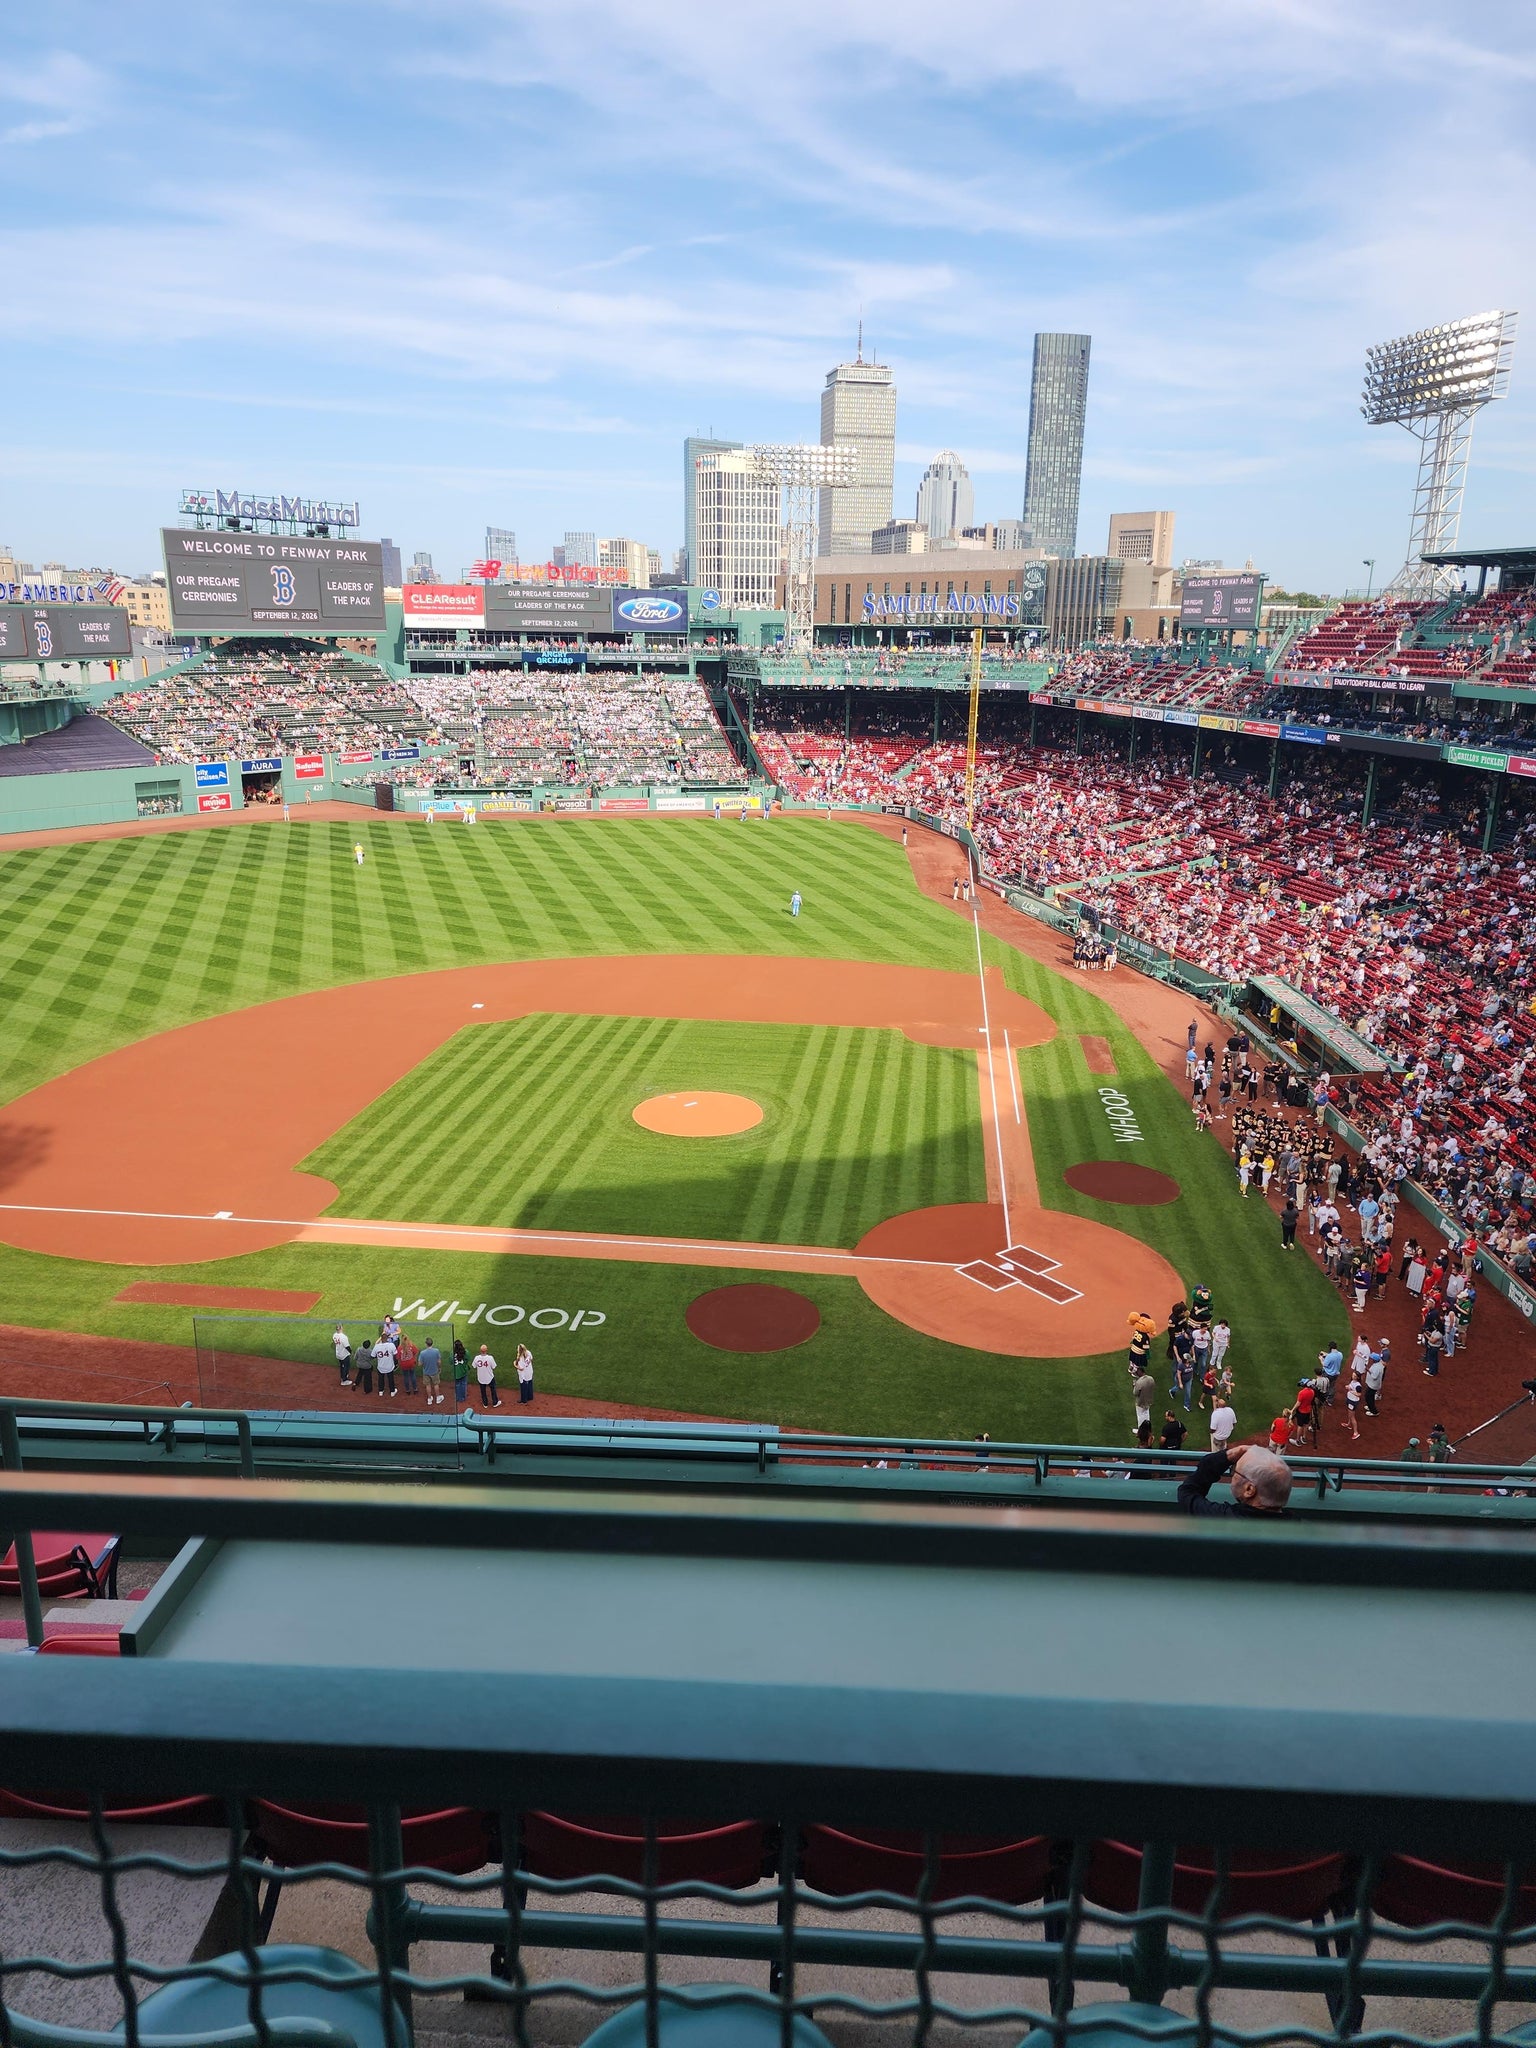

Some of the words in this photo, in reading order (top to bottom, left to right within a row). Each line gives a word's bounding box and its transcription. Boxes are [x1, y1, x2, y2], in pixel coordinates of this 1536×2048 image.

[215, 489, 360, 527] MassMutual
[182, 540, 252, 556] WELCOME
[258, 545, 275, 557] TO
[281, 547, 332, 559] FENWAY
[336, 550, 368, 562] PARK
[176, 575, 195, 585] OUR
[197, 576, 241, 587] PREGAME
[327, 581, 362, 591] LEADERS
[364, 582, 374, 592] OF
[1188, 579, 1210, 587] WELCOME
[22, 583, 96, 602] AMERICA
[182, 591, 238, 602] CEREMONIES
[333, 596, 348, 605] THE
[350, 596, 371, 606] PACK
[411, 593, 476, 605] CLEAResult
[861, 592, 944, 618] SAMUEL
[947, 591, 1020, 617] ADAMS
[631, 600, 670, 619] Ford
[253, 611, 290, 620] SEPTEMBER
[291, 611, 300, 621] 12,
[301, 611, 318, 620] 2026
[78, 622, 102, 631] LEADERS
[103, 622, 111, 631] OF
[83, 634, 95, 643] THE
[95, 634, 110, 643] PACK
[1334, 678, 1349, 686] ENJOY
[1368, 680, 1381, 688] BALL
[1398, 682, 1406, 690] TO
[1406, 683, 1426, 691] LEARN
[1326, 733, 1341, 742] MORE
[295, 762, 324, 770] Safelite
[1481, 756, 1505, 767] PICKLES
[423, 801, 450, 811] jetBlue
[483, 800, 514, 811] GRANITE
[515, 800, 530, 810] CITY
[557, 800, 588, 809] wasabi
[1098, 1088, 1145, 1142] WHOOP
[393, 1297, 607, 1331] WHOOP
[376, 1350, 390, 1359] 34
[476, 1360, 489, 1368] 34
